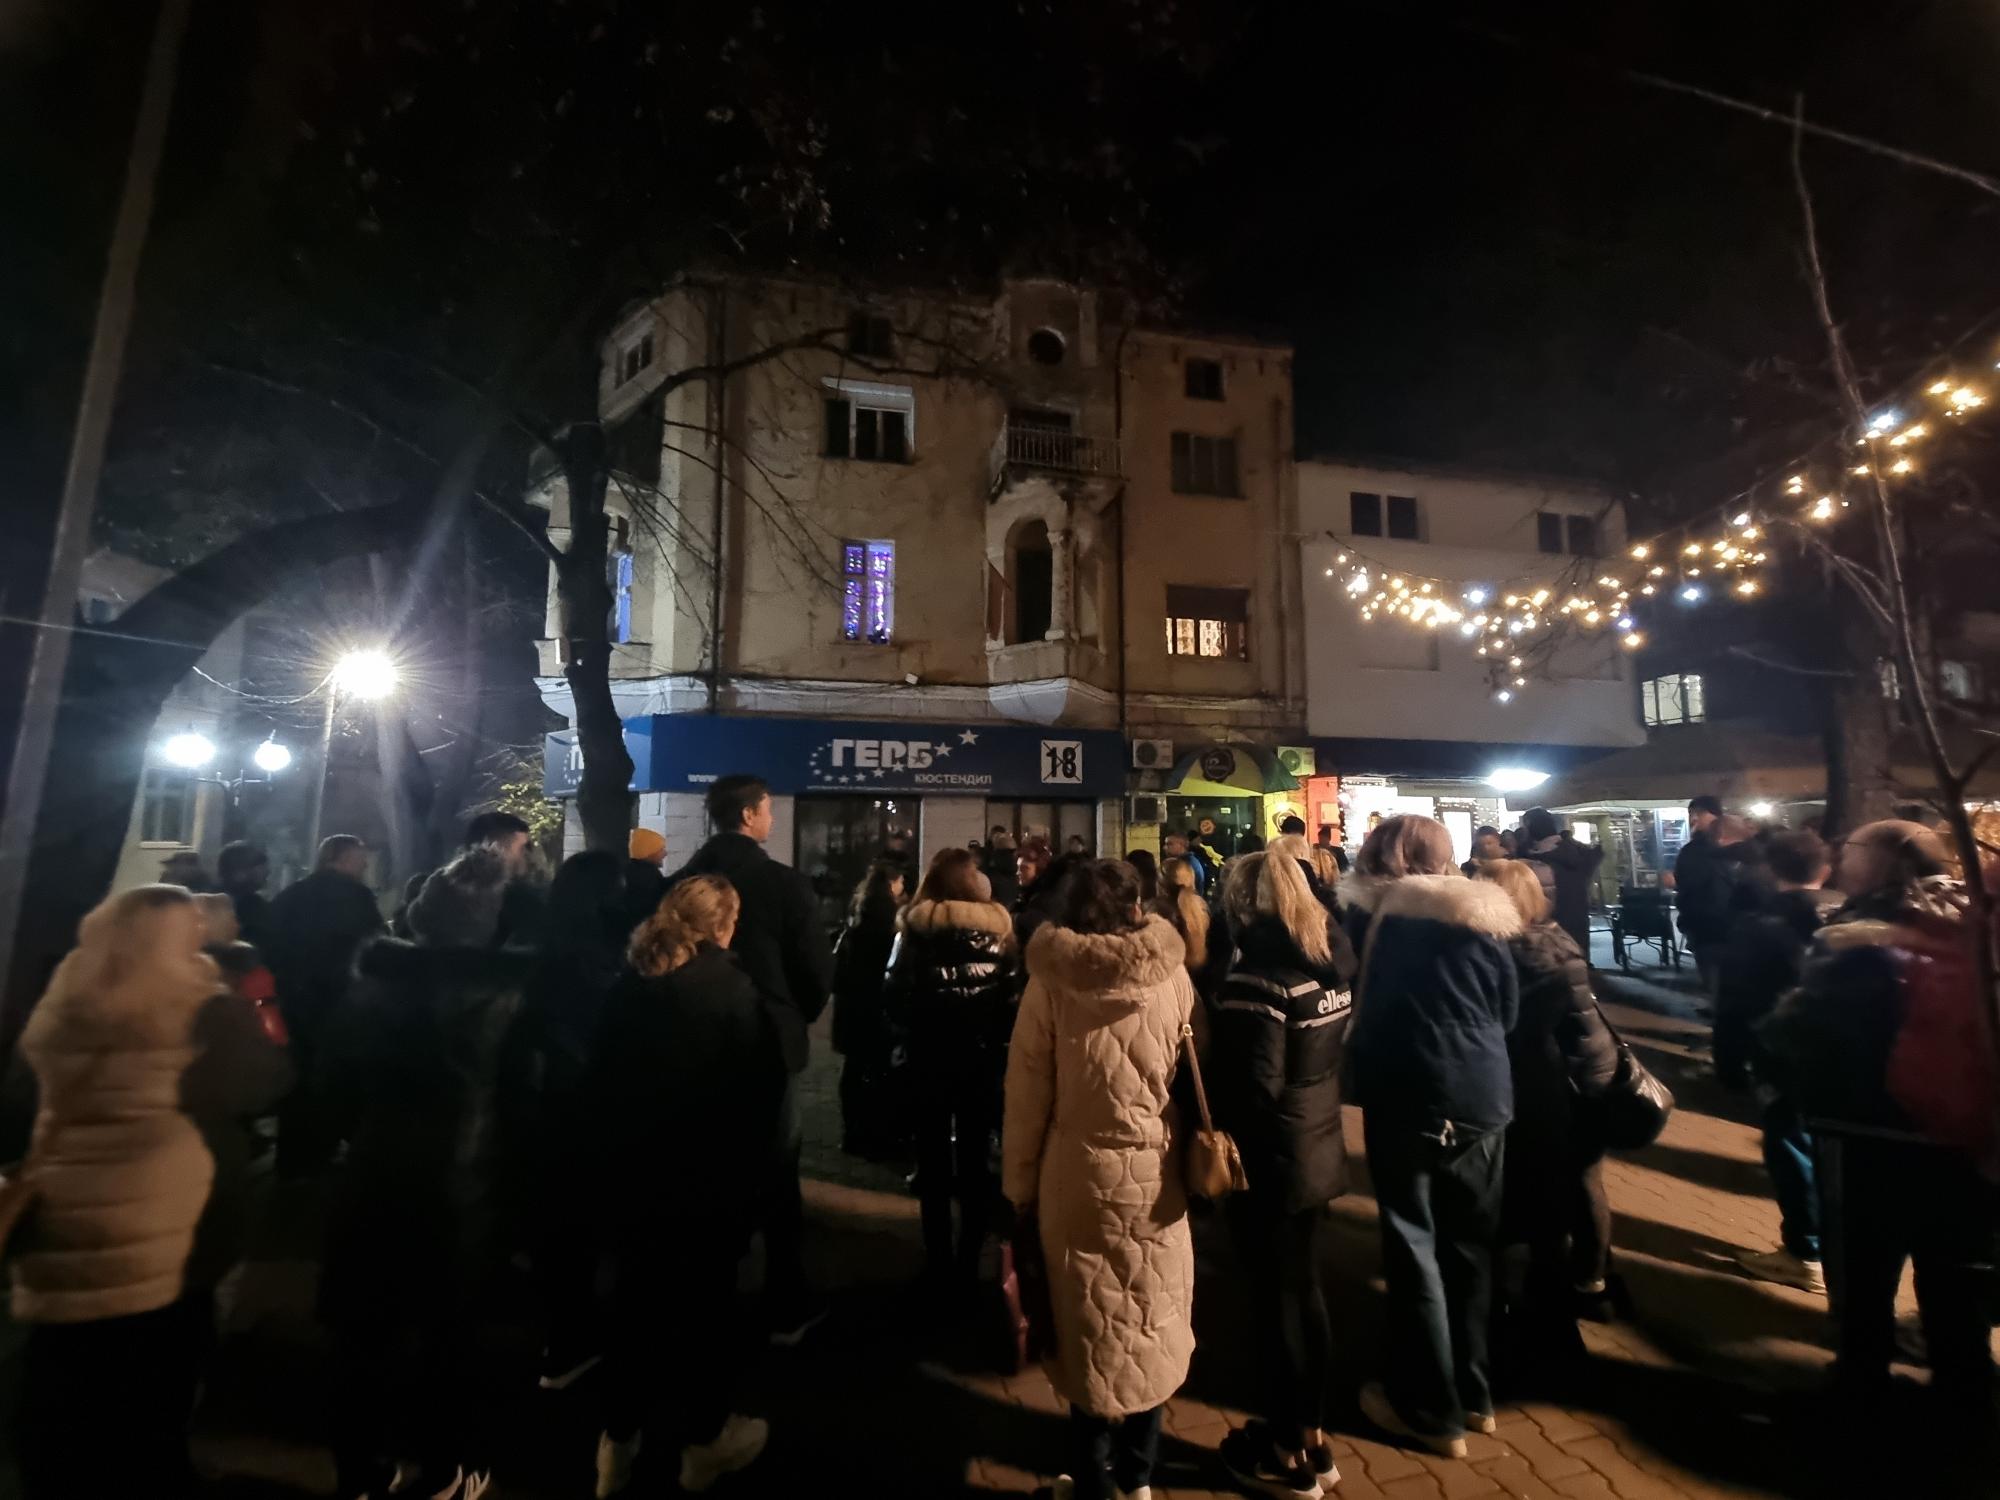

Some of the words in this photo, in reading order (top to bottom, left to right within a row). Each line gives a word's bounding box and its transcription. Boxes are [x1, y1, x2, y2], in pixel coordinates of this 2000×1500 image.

[832, 739, 933, 769] ГЕРБ
[1046, 747, 1076, 778] 18
[914, 773, 992, 786] КЮСТЕНДИЛ
